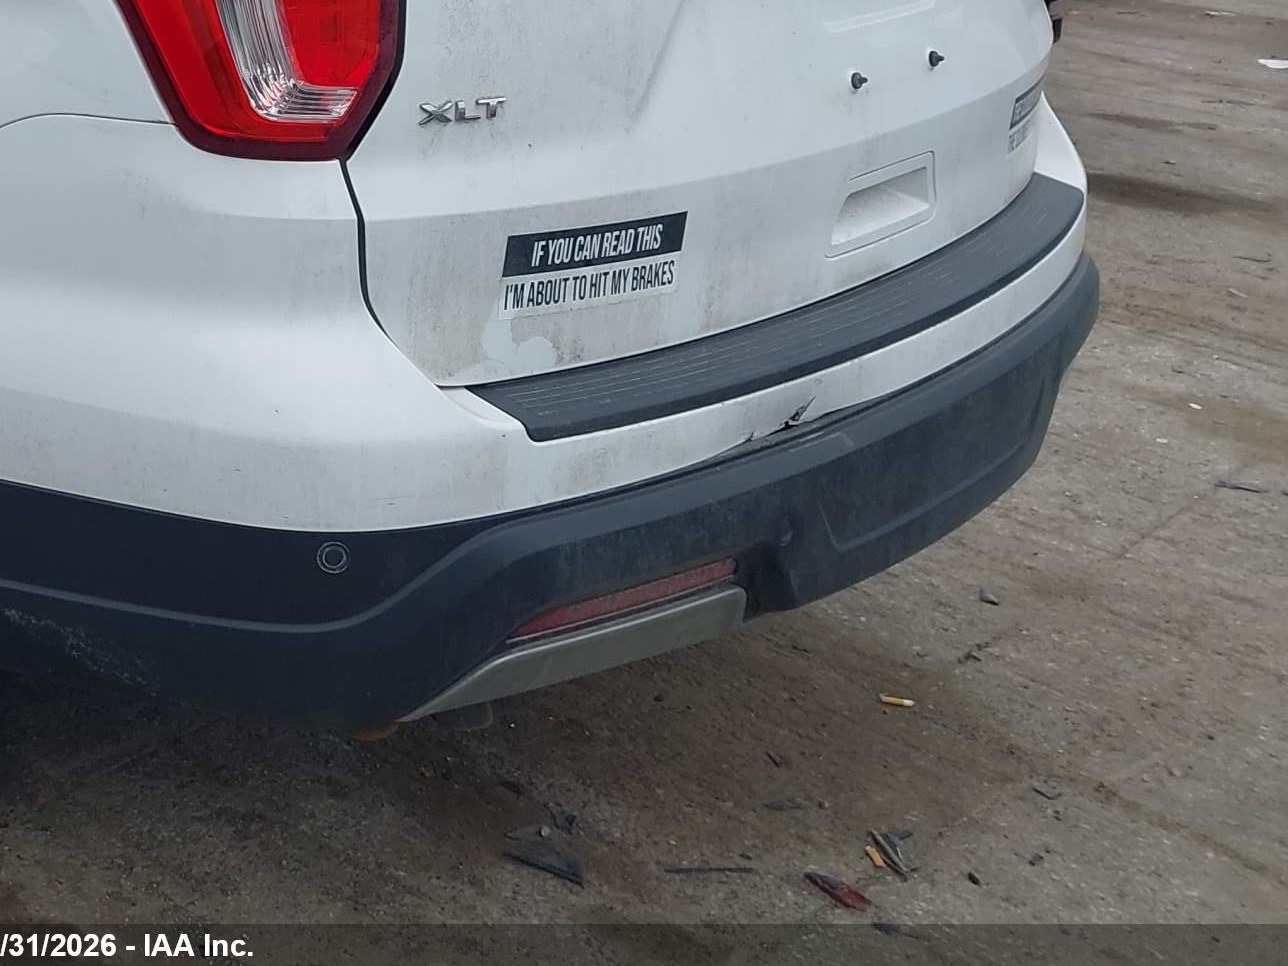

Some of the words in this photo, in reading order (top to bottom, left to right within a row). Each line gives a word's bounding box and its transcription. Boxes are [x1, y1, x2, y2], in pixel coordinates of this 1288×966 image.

[418, 95, 508, 127] XLT
[530, 240, 547, 267] IF
[547, 237, 574, 266] YOU
[574, 233, 602, 262] CAN
[601, 228, 636, 258] READ
[635, 223, 664, 253] THIS
[503, 282, 525, 311] I'M
[526, 276, 570, 308] ABOUT
[572, 274, 588, 301] TO
[588, 270, 611, 300] HIT
[610, 267, 631, 296] MY
[630, 259, 676, 293] BRAKES
